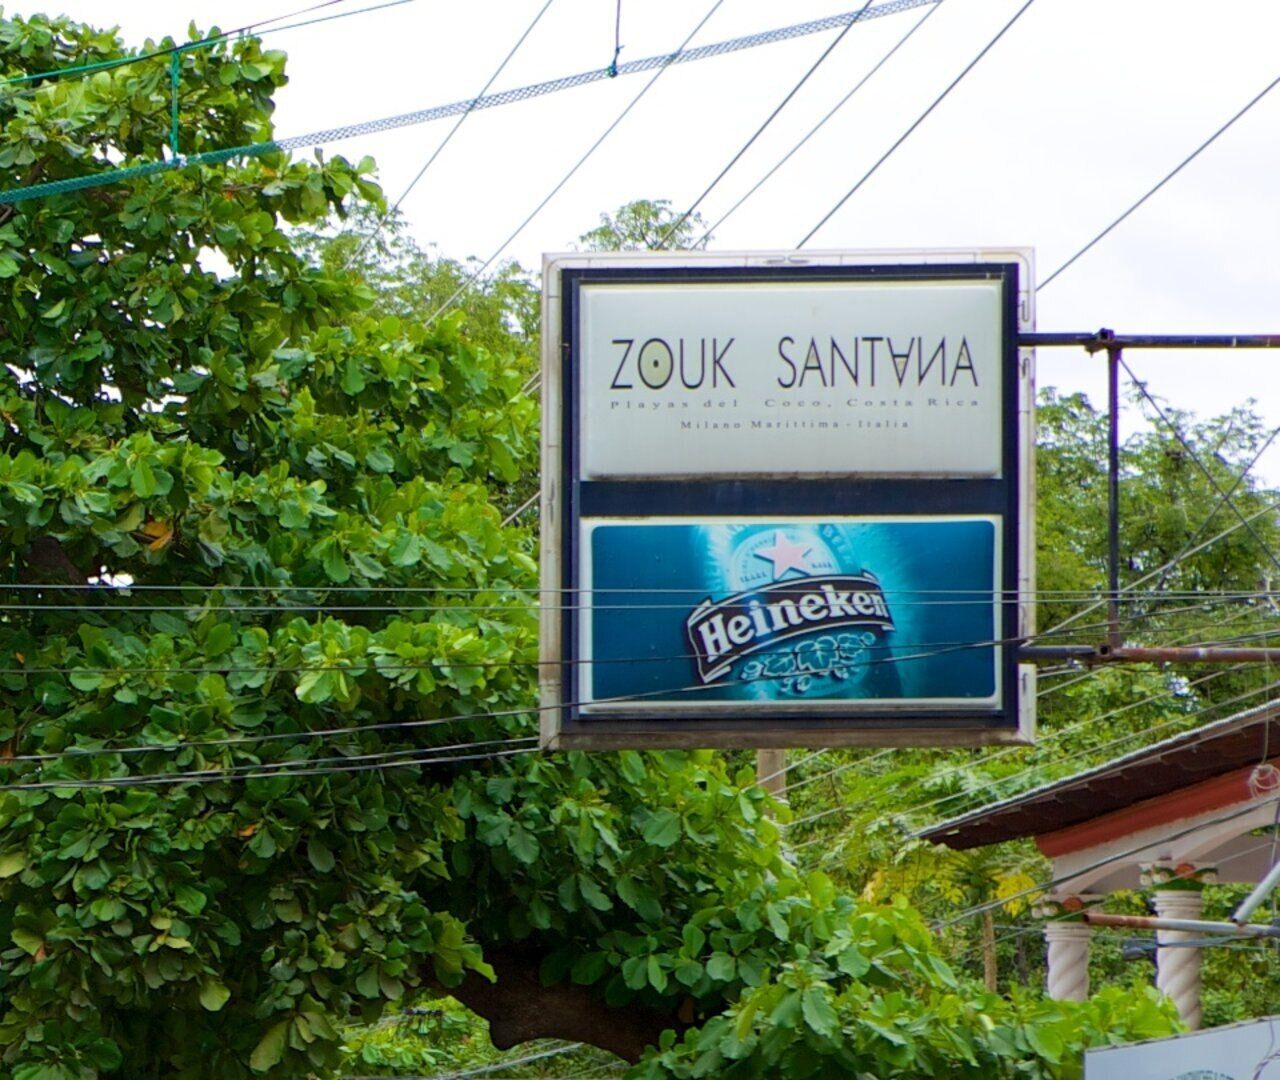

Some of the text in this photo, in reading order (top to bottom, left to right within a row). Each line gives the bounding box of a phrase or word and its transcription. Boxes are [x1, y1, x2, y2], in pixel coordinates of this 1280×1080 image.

[610, 337, 736, 390] ZOUK
[610, 398, 979, 410] Playas del Coco, Costa Rica
[680, 420, 741, 429] Milano
[858, 419, 909, 429] Italia
[698, 584, 889, 663] Heineken
